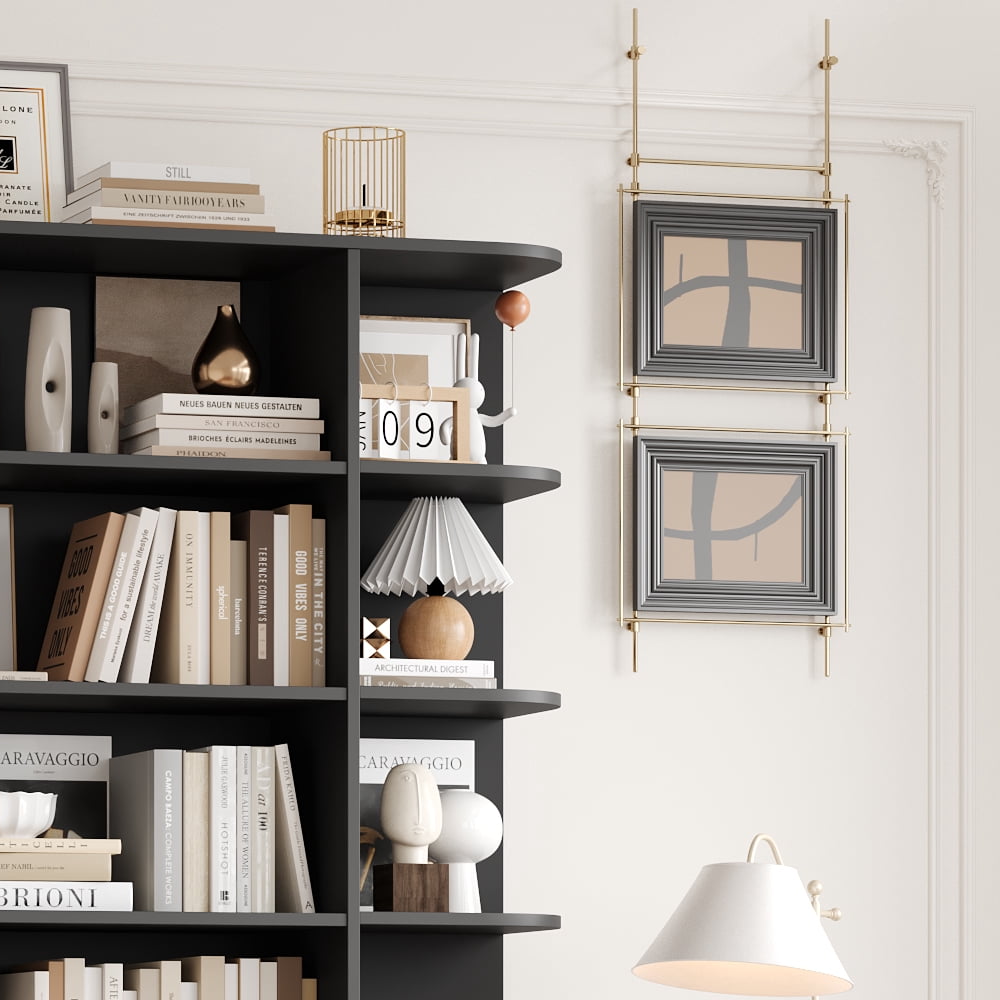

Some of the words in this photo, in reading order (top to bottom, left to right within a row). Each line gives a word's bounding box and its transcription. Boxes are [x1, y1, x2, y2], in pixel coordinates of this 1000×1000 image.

[166, 166, 191, 179] STILL
[179, 400, 205, 408] NEUES
[206, 401, 232, 409] BAUEN
[234, 402, 260, 410] NEUES
[262, 403, 303, 412] GESTALTEN
[205, 419, 224, 427] SAN
[226, 420, 281, 429] FRANCISCO
[188, 435, 223, 443] BRIOCHES
[225, 434, 253, 444] ÉCLAIRS
[255, 437, 297, 445] MADELEINES
[176, 450, 227, 458] PHAIDON
[185, 533, 193, 548] ON
[67, 545, 94, 579] GOOD
[120, 611, 128, 621] for
[126, 560, 141, 602] sustainable
[136, 529, 149, 559] lifestyle
[258, 547, 267, 585] TERENCE
[295, 550, 308, 576] GOOD
[185, 553, 193, 608] IMMUNITY
[56, 585, 85, 620] VIBES
[100, 620, 110, 639] THIS
[110, 578, 120, 604] GOOD
[116, 552, 128, 577] GUIDE
[258, 585, 267, 622] CONRAN'S
[295, 584, 308, 612] VIBES
[314, 592, 324, 618] THE
[47, 626, 73, 660] ONLY
[295, 618, 308, 642] ONLY
[314, 621, 324, 655] CITY
[375, 664, 438, 673] ARCHITECTURAL
[440, 665, 469, 674] DIGEST
[220, 822, 229, 875] HOTSHOT
[242, 833, 249, 844] OF
